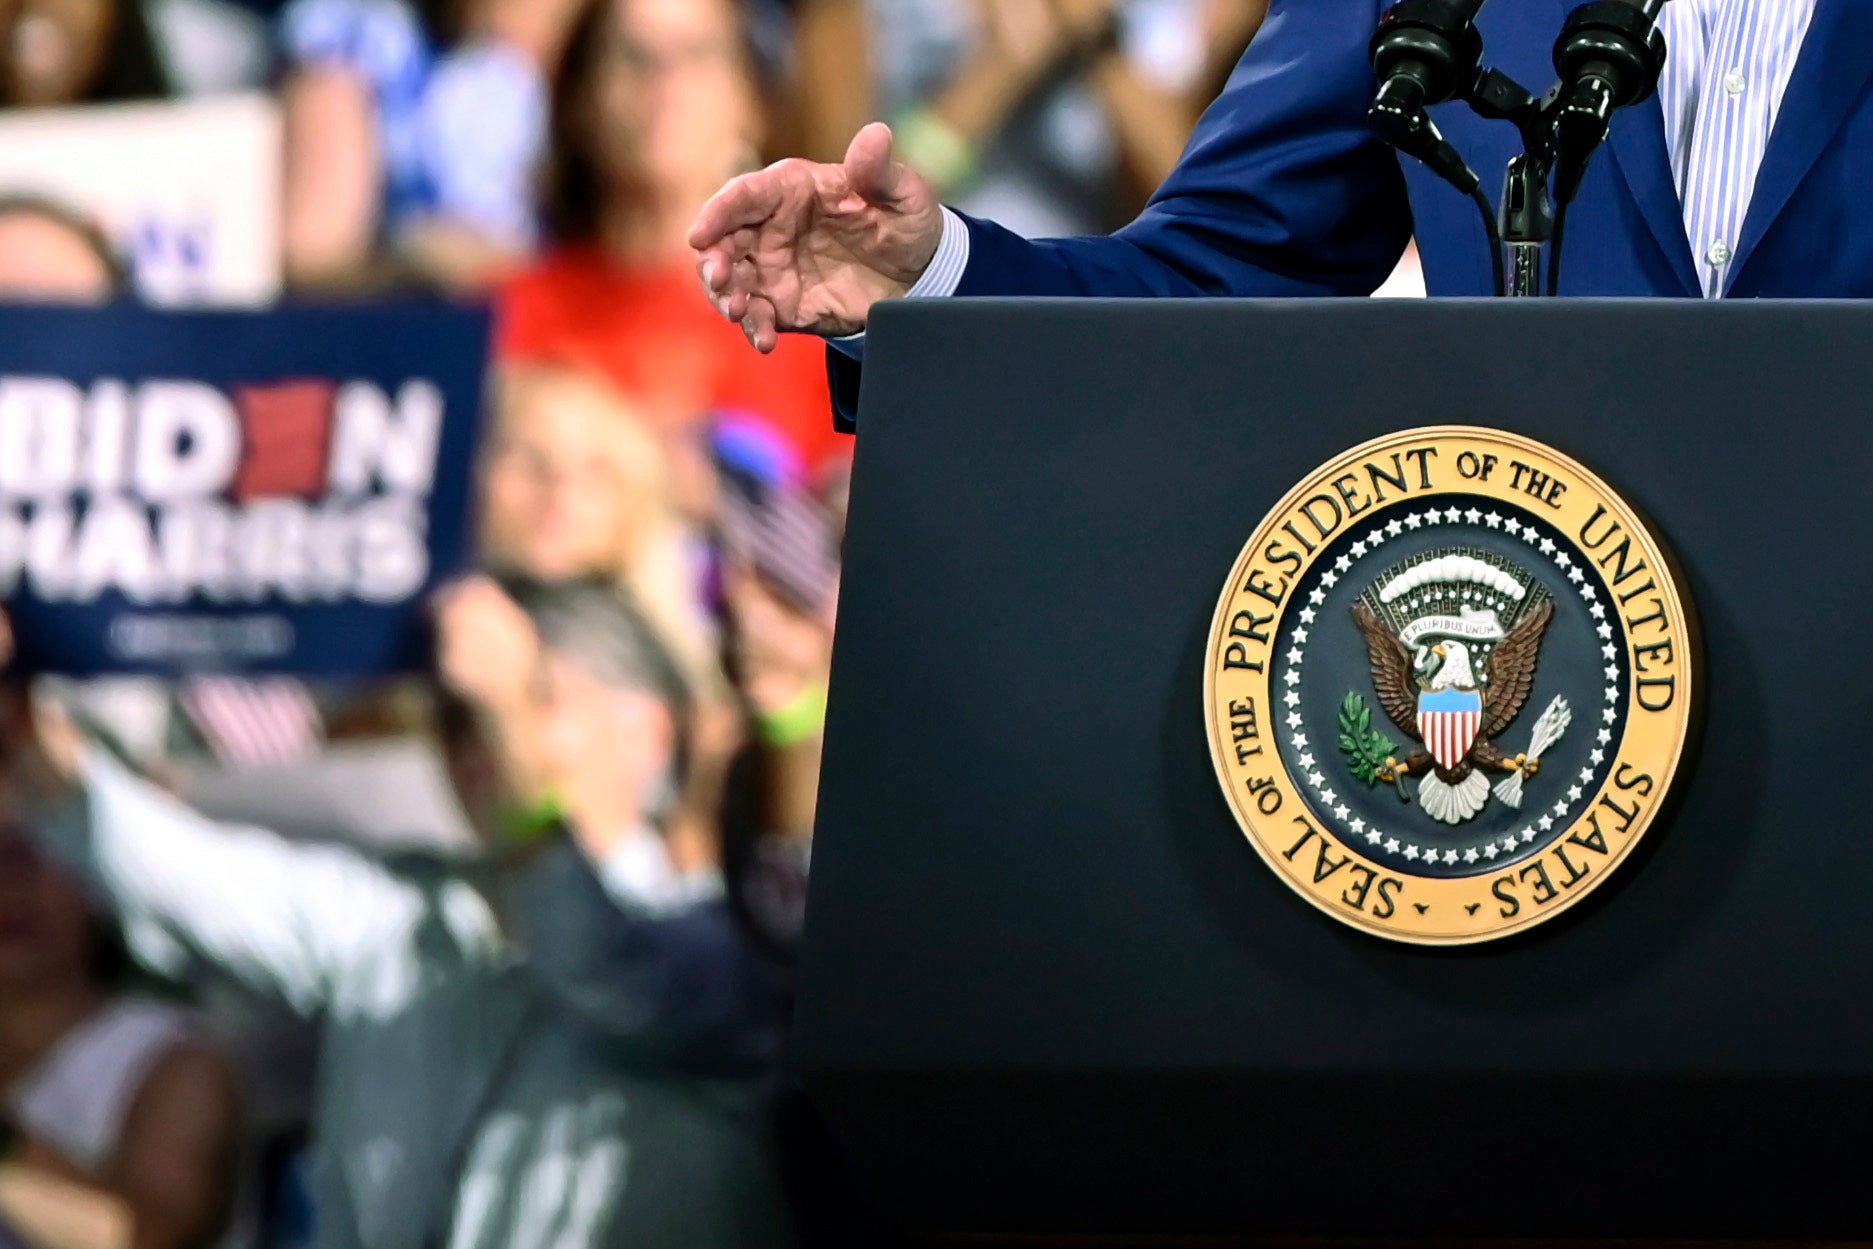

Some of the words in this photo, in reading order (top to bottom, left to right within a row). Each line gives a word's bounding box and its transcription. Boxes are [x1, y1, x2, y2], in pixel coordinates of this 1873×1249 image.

[0, 376, 445, 500] BIDEN
[1456, 450, 1499, 481] OF
[1508, 460, 1568, 510] THE
[1223, 446, 1439, 675] PRESIDENT
[1411, 618, 1464, 634] PLURIBUS
[1464, 624, 1497, 636] UNUM
[1578, 503, 1676, 713] UNITED
[1228, 695, 1263, 766] THE
[1245, 774, 1284, 816] OF
[1281, 819, 1404, 920] SEAL
[1490, 762, 1654, 920] STATES
